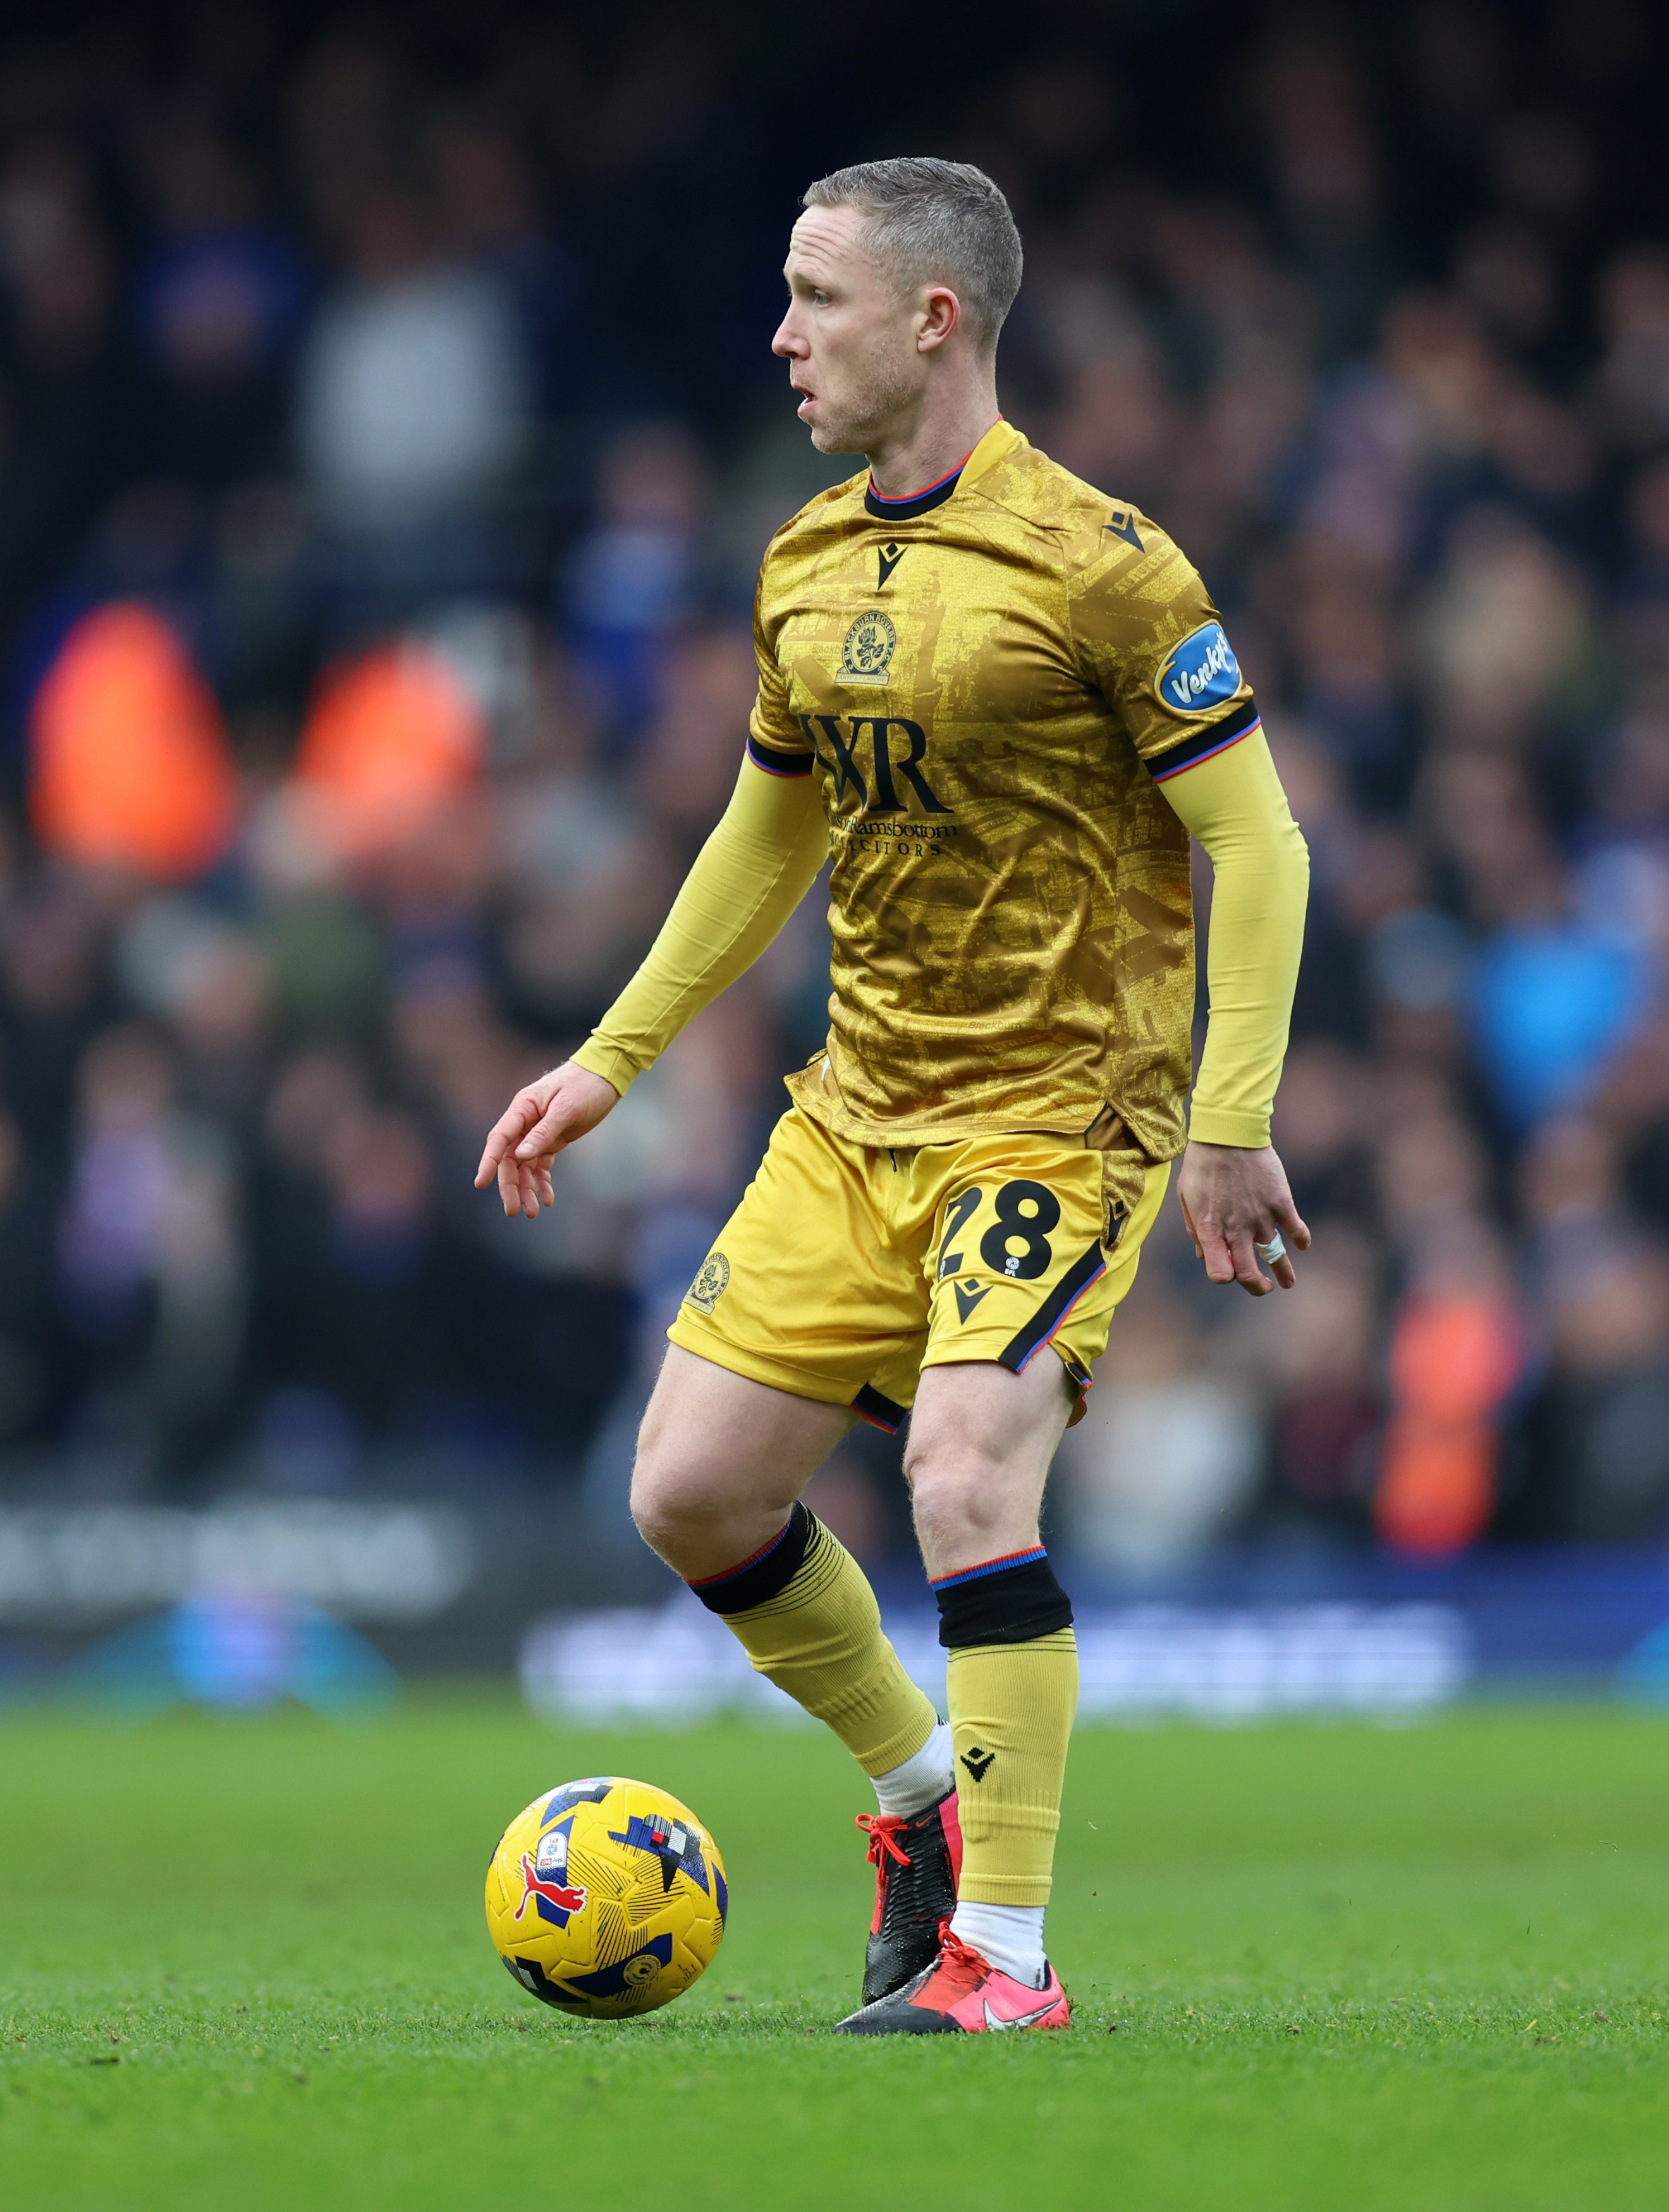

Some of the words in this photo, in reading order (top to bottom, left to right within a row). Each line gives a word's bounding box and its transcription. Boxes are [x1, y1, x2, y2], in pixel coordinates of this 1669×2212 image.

[844, 614, 874, 661] BLACKBURN
[876, 614, 894, 643] ROVERS
[938, 1178, 1061, 1282] 28
[1004, 1268, 1016, 1277] EFL
